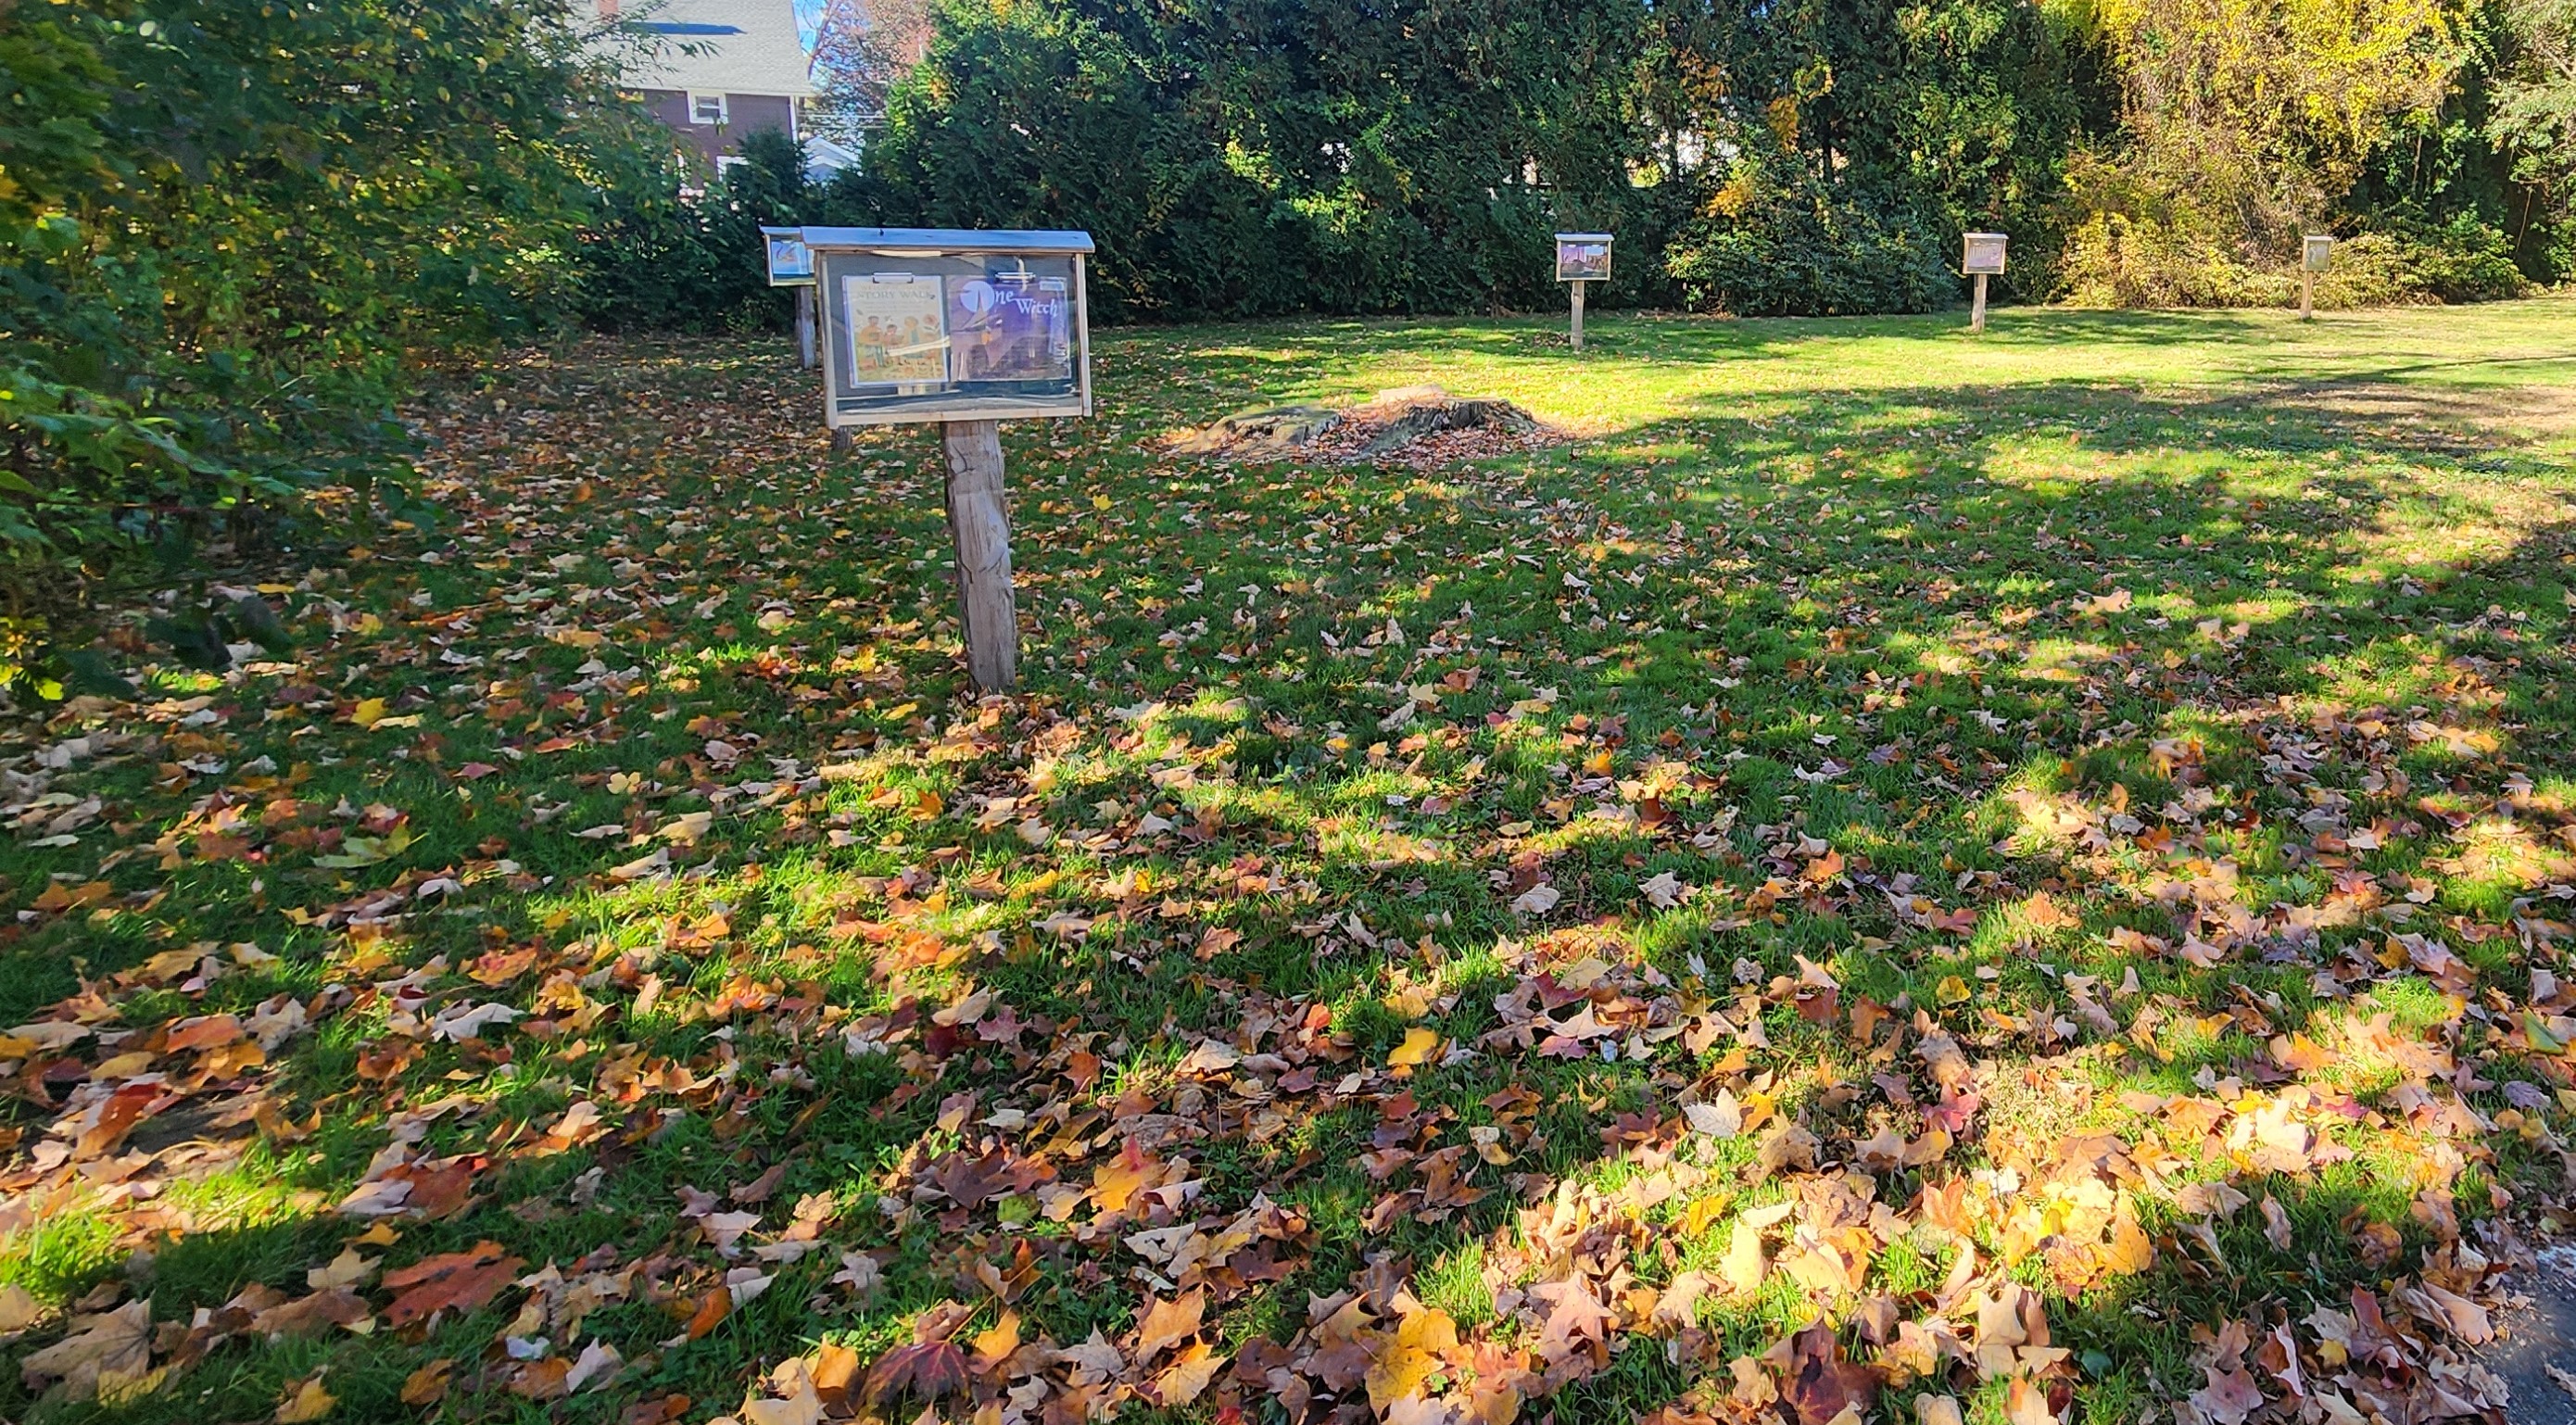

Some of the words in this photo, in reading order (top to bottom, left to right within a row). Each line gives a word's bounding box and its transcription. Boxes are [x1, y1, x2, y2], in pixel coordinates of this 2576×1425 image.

[858, 290, 895, 299] STORY
[898, 290, 933, 299] WALK
[960, 281, 1016, 313] One
[1016, 297, 1058, 317] Witch
